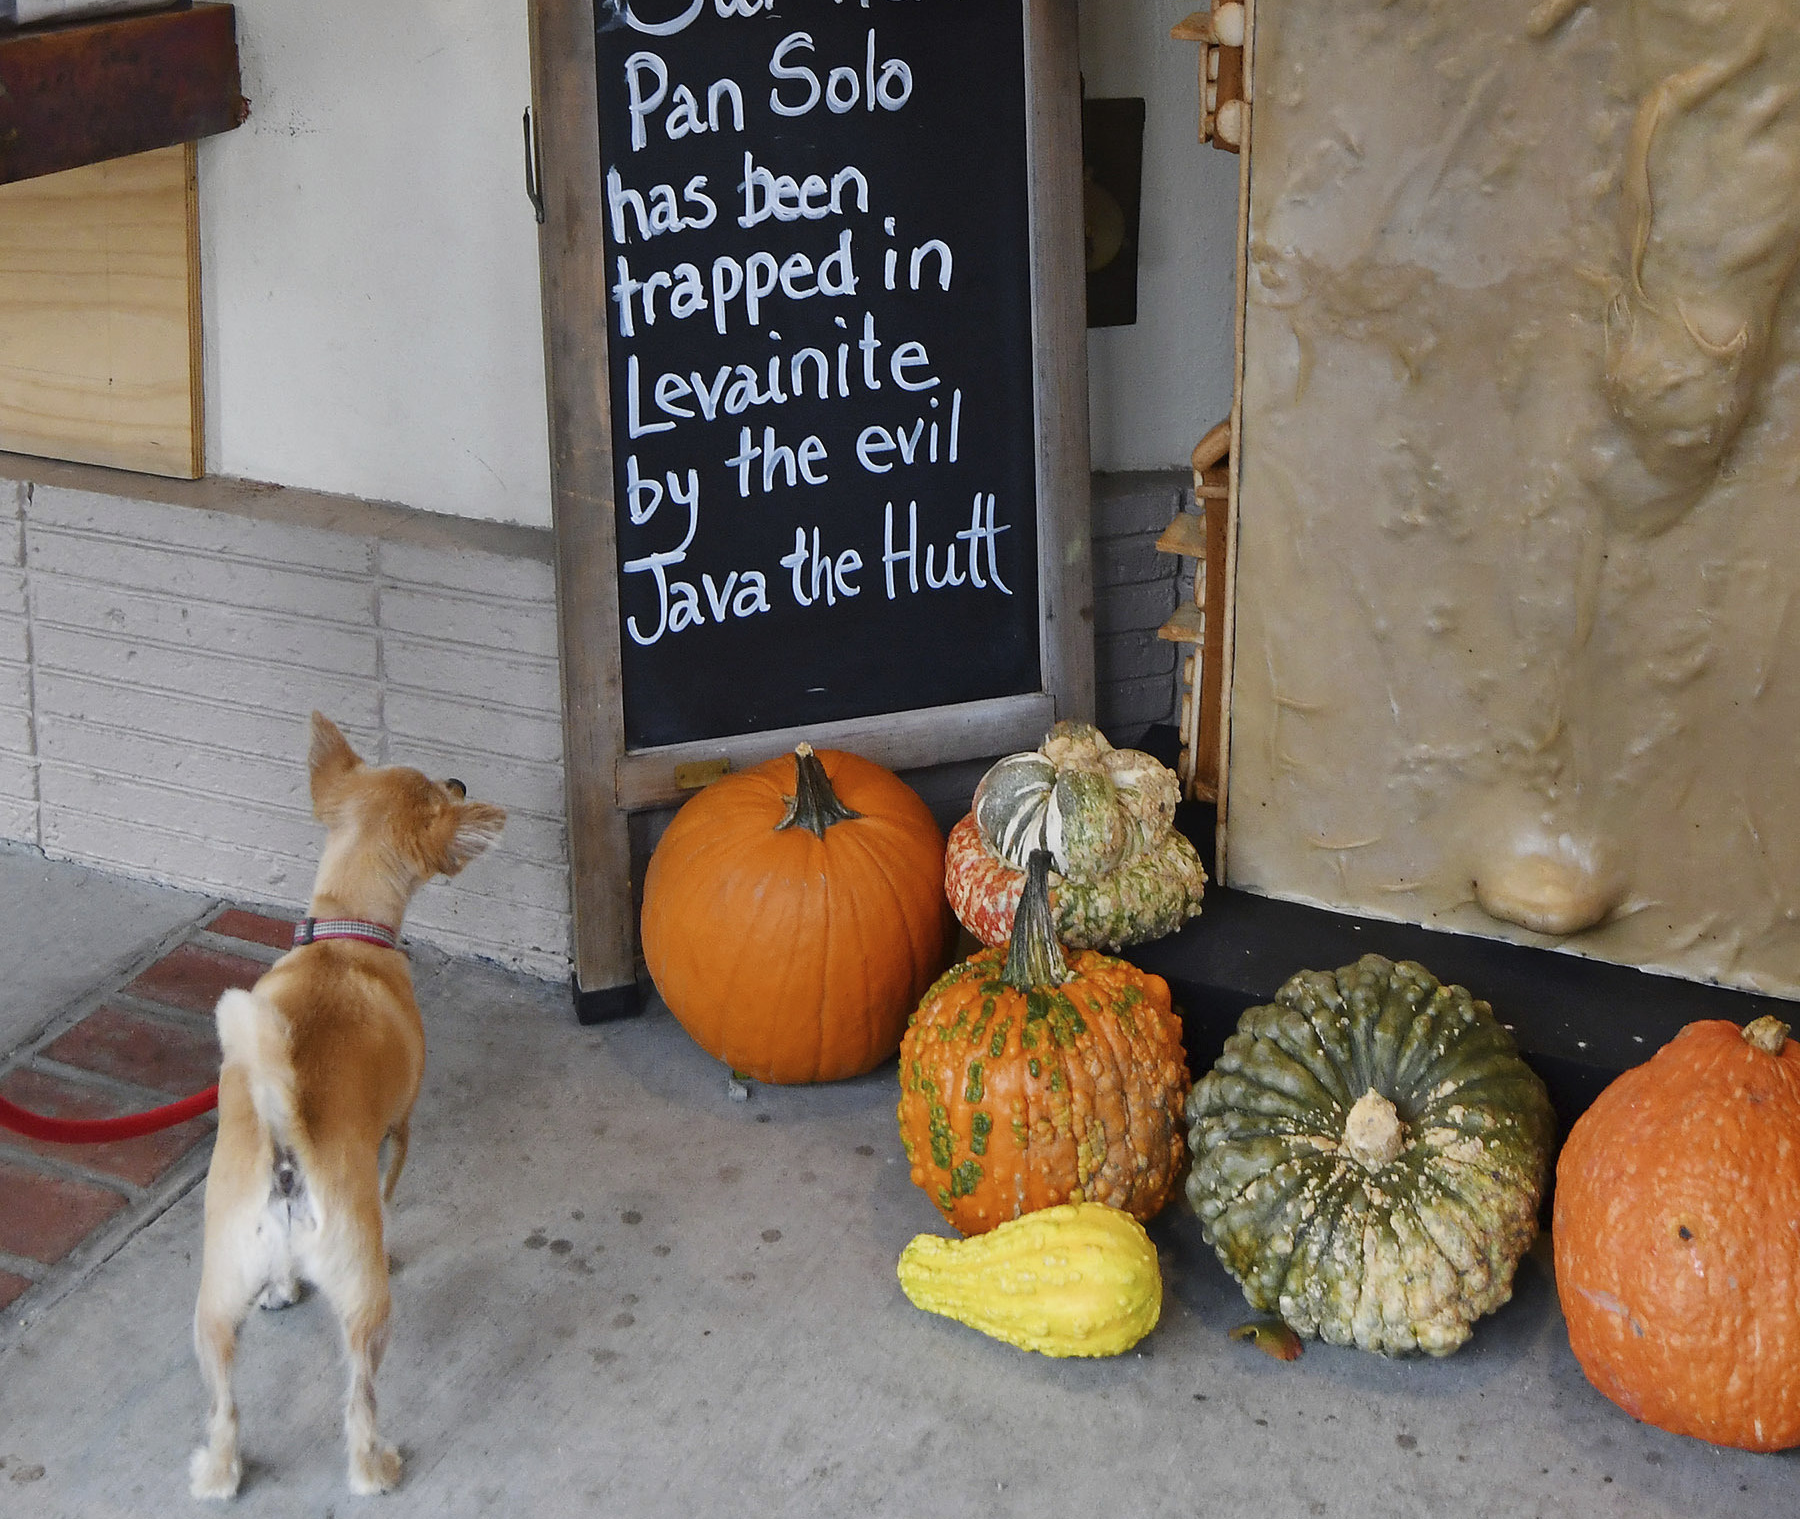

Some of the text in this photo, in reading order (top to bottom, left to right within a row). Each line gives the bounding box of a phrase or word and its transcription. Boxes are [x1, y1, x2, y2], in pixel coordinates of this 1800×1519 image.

[624, 28, 913, 152] Pan Solo
[606, 150, 869, 244] has been
[612, 216, 955, 338] trapped in
[627, 310, 941, 439] Levainite
[626, 388, 962, 554] by the evil
[622, 492, 1014, 646] Java the Hutt
